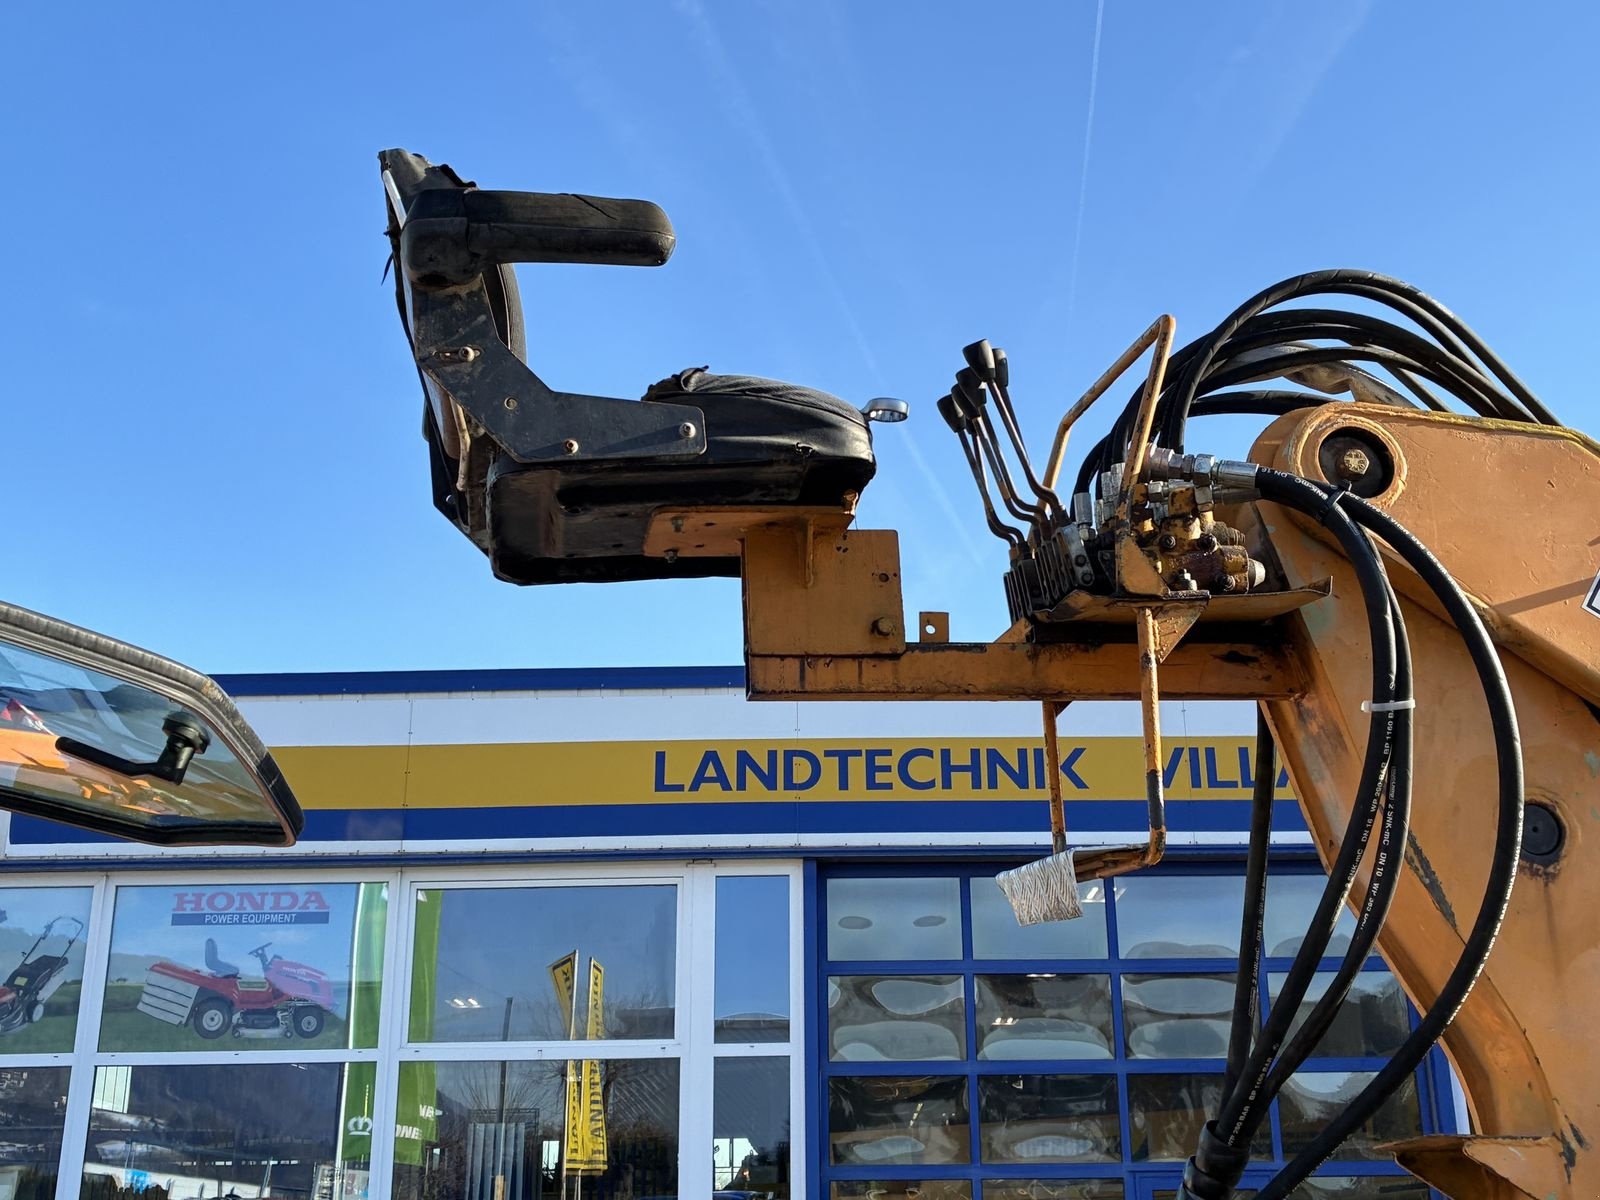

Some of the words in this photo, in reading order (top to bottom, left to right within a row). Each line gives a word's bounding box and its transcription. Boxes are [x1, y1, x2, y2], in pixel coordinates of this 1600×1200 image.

[1386, 721, 1394, 741] 1160
[1384, 742, 1391, 755] BP
[653, 747, 1090, 792] LANDTECHNIK
[1163, 746, 1290, 789] VILL
[1370, 799, 1379, 813] WP
[1366, 818, 1374, 828] 16
[1382, 811, 1394, 847] SNK-mC
[1361, 829, 1370, 843] DN
[1379, 852, 1388, 866] DN
[1375, 865, 1384, 877] 10
[172, 890, 330, 912] HONDA
[205, 914, 239, 924] POWER
[242, 913, 297, 924] EQUIPMENT
